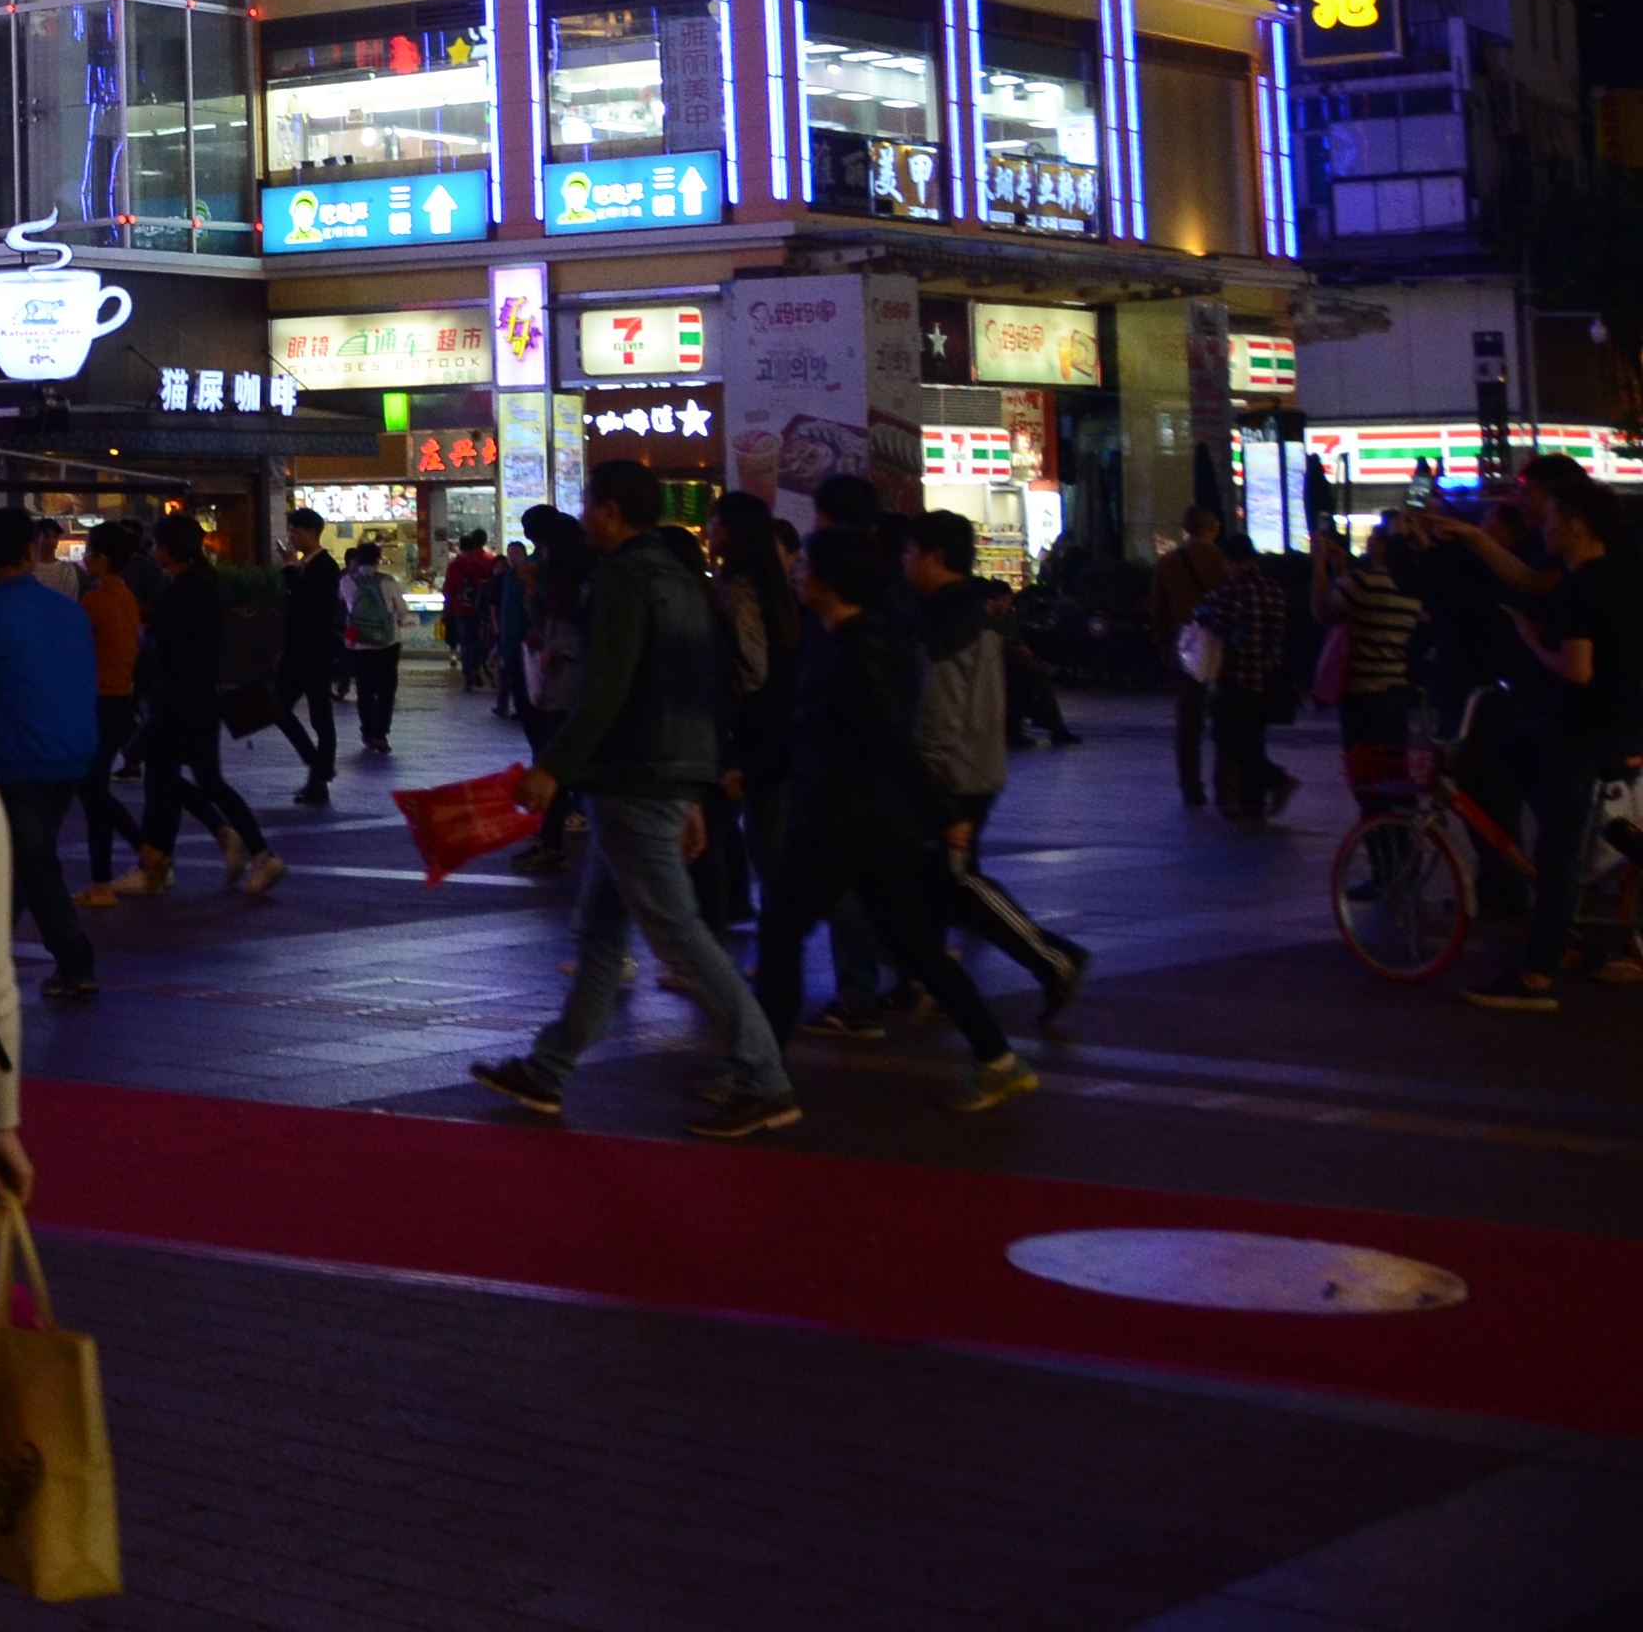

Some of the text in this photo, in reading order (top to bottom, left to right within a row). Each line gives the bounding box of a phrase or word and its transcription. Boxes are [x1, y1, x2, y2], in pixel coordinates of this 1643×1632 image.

[287, 327, 483, 359] 眼镜 直通车 超市
[613, 317, 643, 365] 7
[287, 356, 481, 375] GLASSES GOTOOK
[159, 368, 297, 416] 猫屎咖啡
